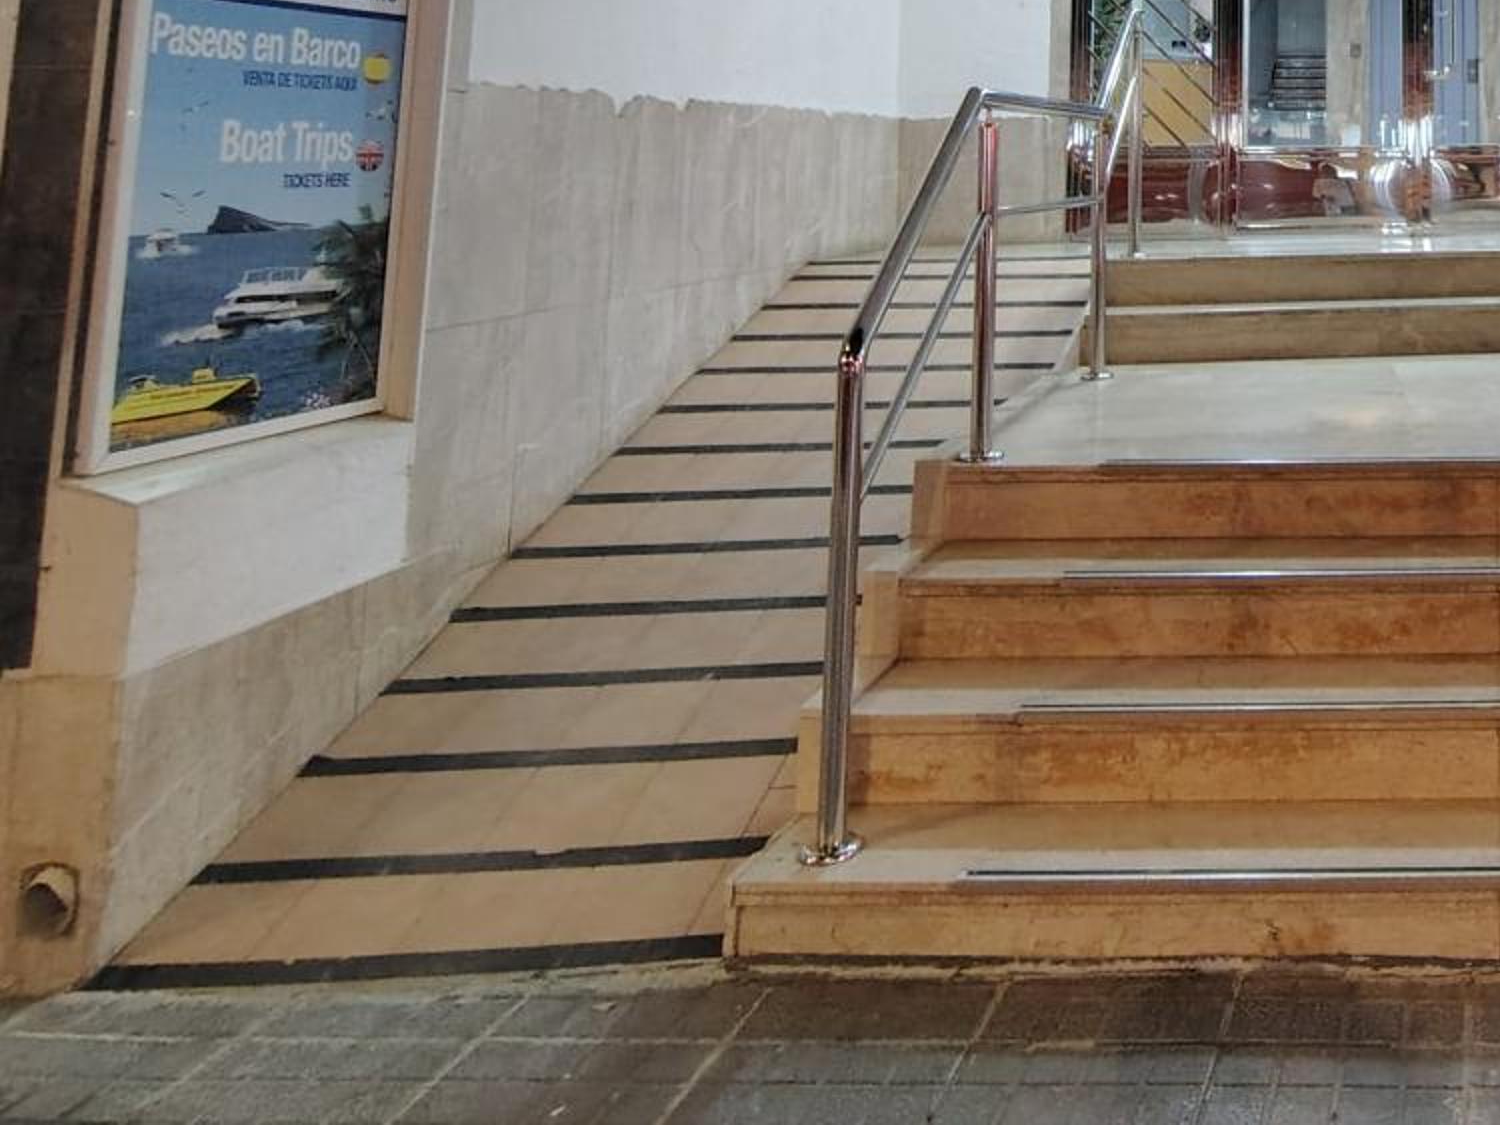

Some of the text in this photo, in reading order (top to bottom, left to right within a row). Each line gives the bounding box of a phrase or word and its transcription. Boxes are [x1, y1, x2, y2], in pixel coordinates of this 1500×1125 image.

[151, 11, 361, 69] Paseos en Barco
[220, 119, 353, 171] Boat Trips
